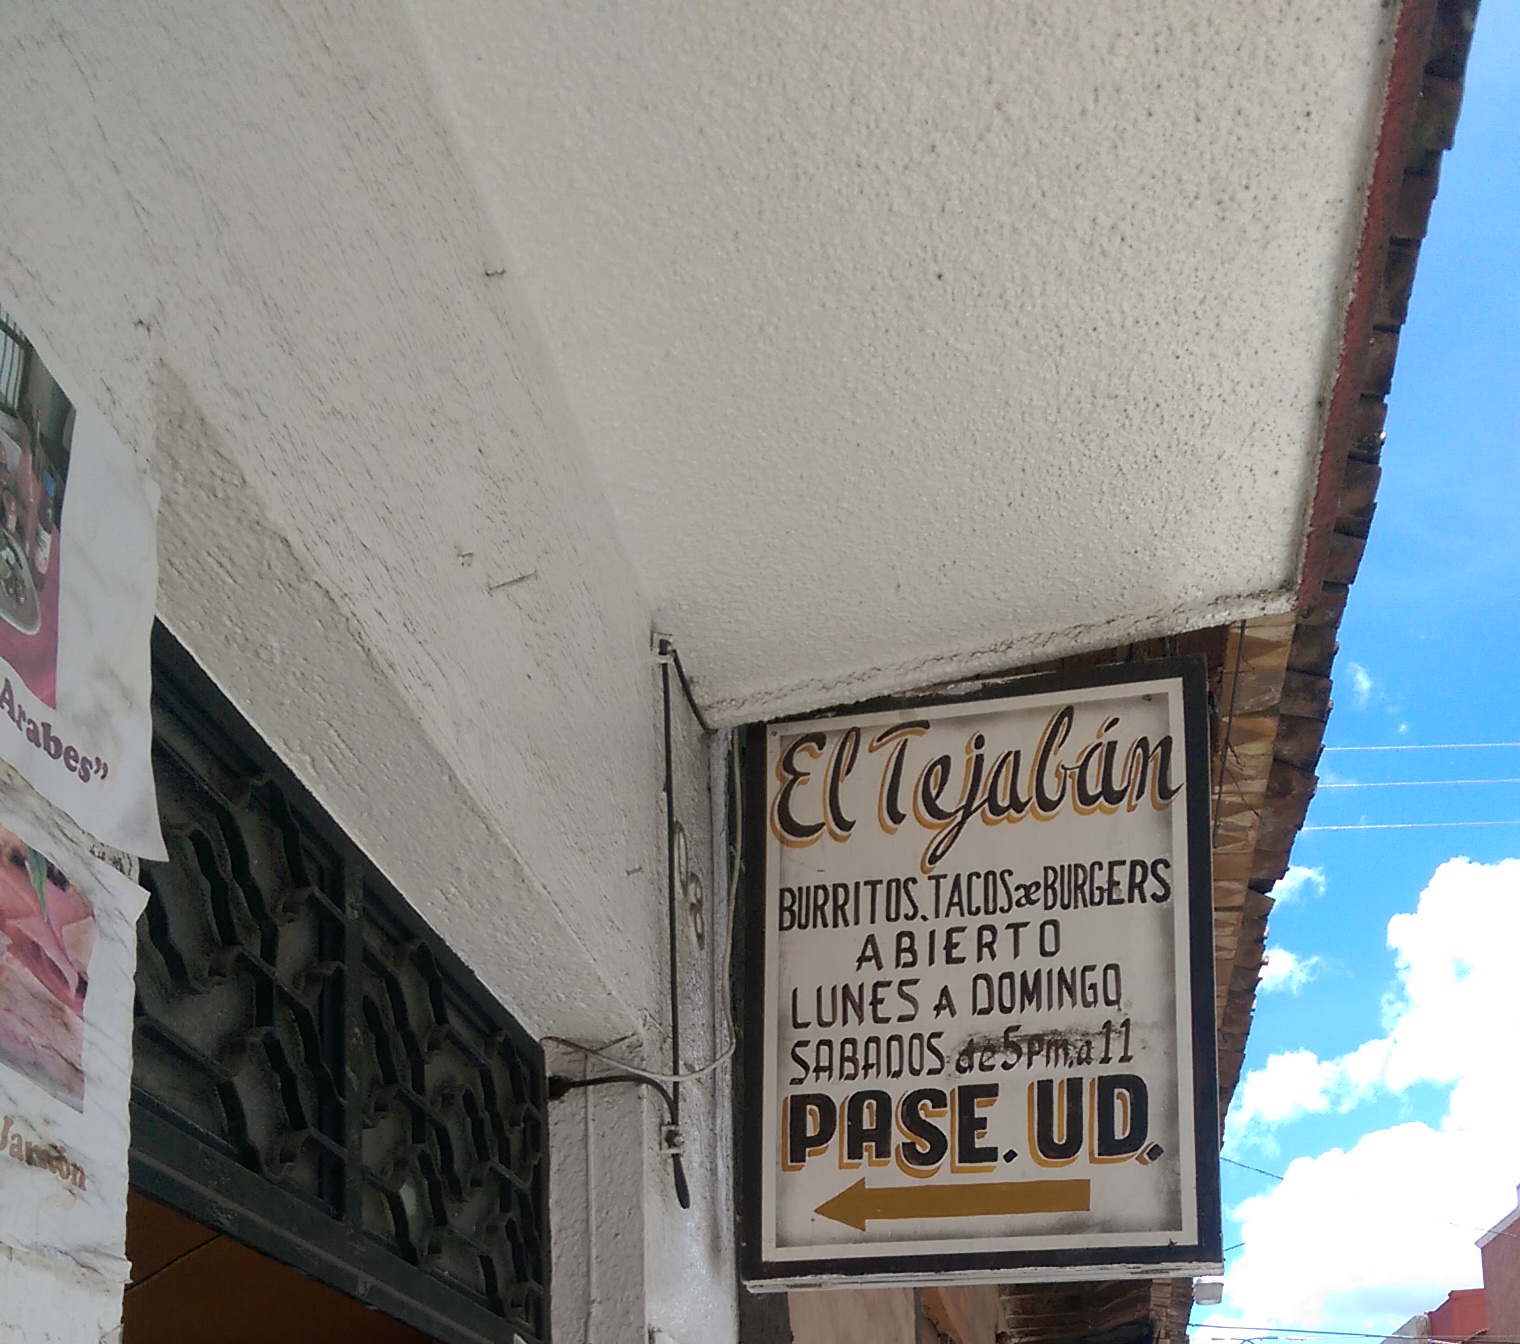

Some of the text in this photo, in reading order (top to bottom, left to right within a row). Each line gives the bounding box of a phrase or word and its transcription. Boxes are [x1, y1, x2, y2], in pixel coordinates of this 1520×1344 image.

[770, 705, 1184, 874] El Tejabán
[929, 868, 1014, 920] TACOS
[1042, 858, 1173, 911] BURGERS
[856, 919, 1061, 972] ABIERTO
[791, 962, 1124, 1030] LUNES A DOMINGO
[790, 1030, 946, 1086] SABADOS
[1098, 1018, 1134, 1065] 11
